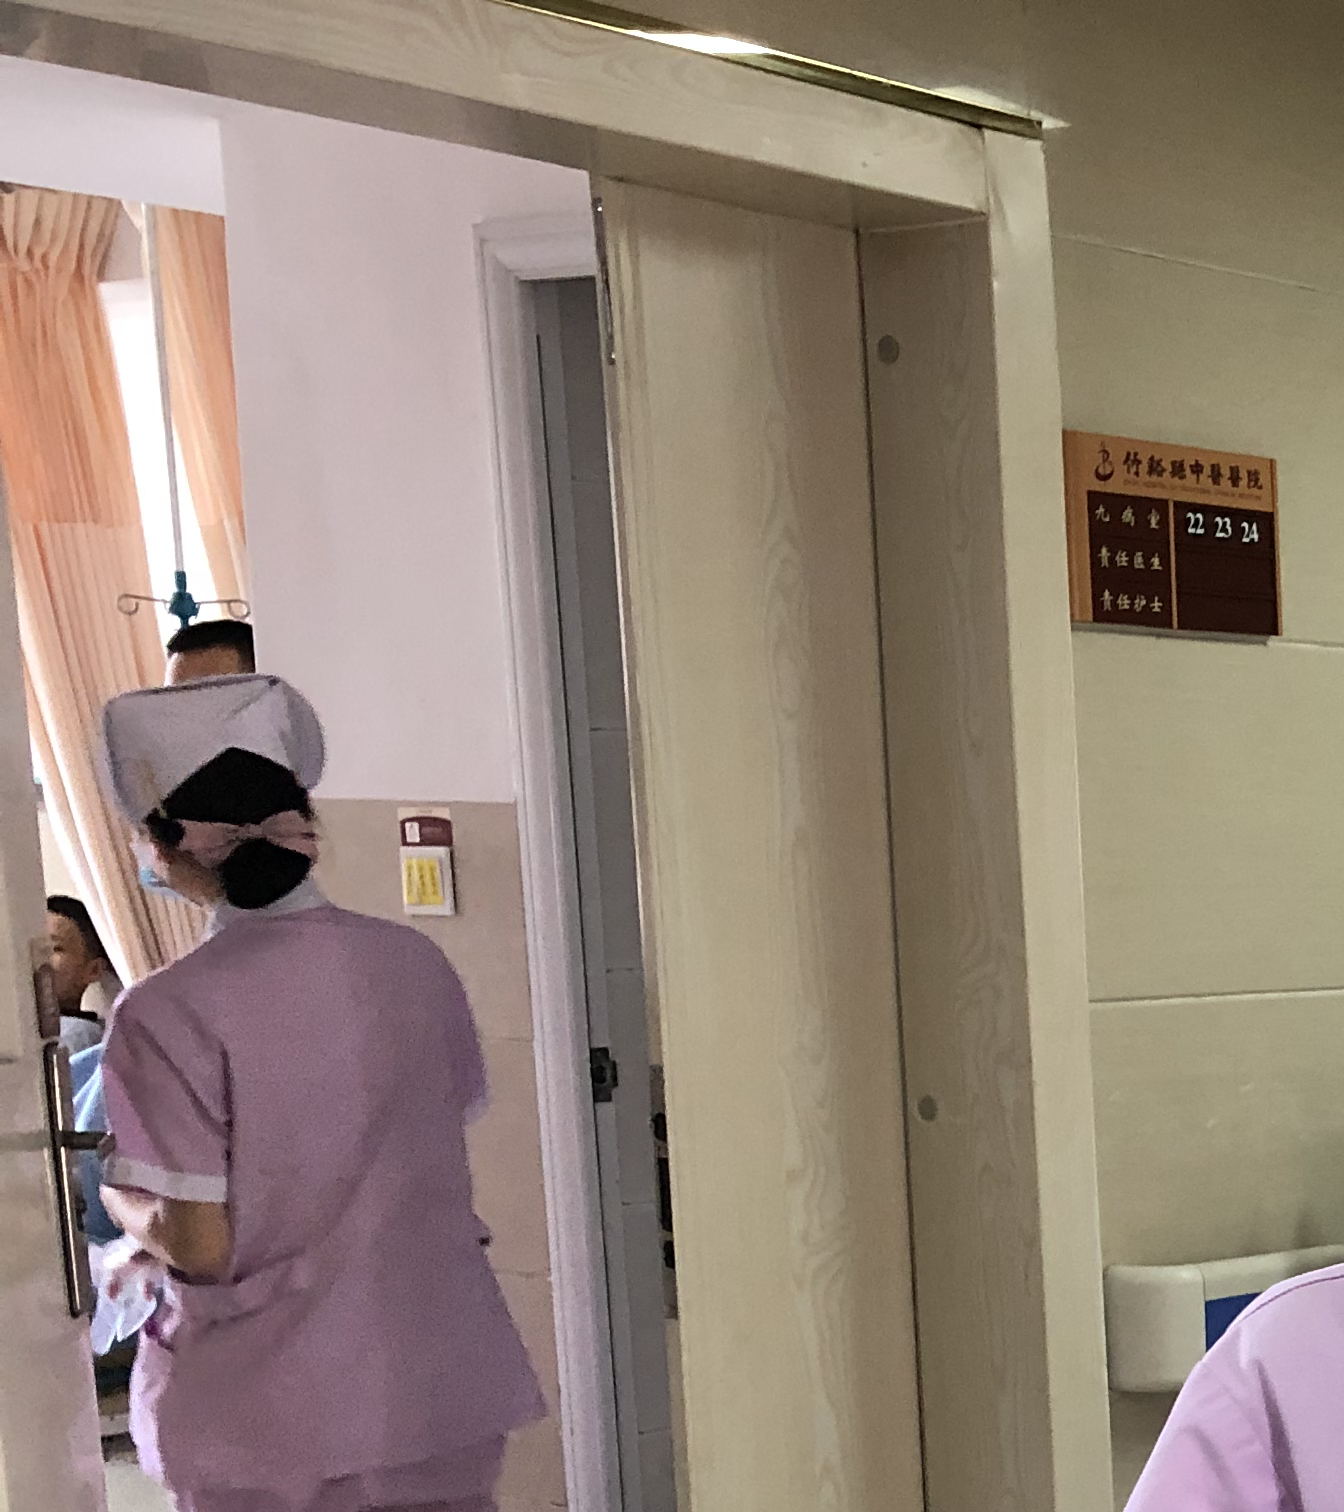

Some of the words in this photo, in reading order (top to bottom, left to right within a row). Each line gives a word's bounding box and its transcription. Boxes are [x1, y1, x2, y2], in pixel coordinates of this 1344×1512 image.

[1186, 512, 1205, 535] 22
[1214, 516, 1232, 538] 23
[1241, 521, 1259, 543] 24
